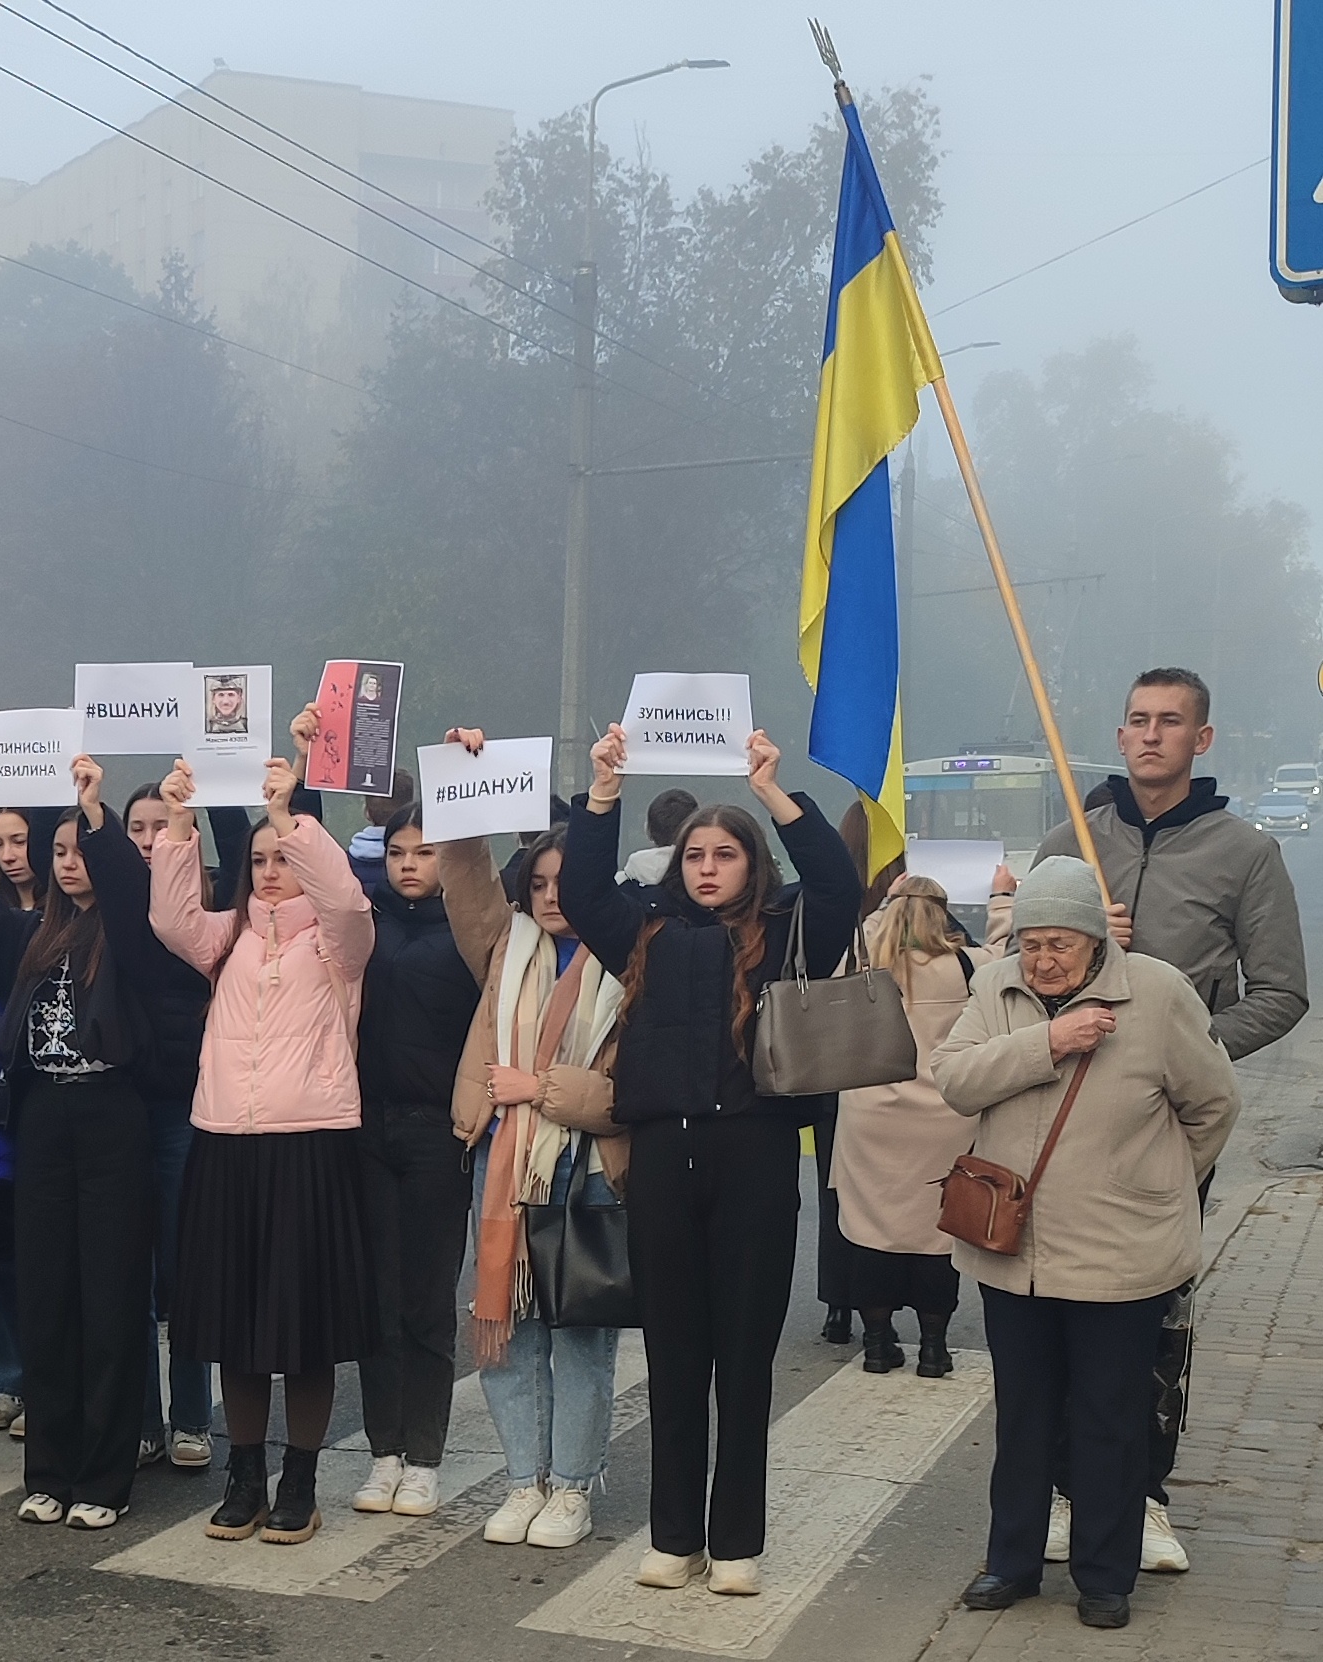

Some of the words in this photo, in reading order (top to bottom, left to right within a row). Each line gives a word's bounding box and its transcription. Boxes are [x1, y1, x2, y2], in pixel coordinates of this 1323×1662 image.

[86, 697, 179, 719] #ВШАНУЙ
[637, 707, 731, 722] ЗУПИНИСЬ!!!
[644, 731, 651, 743] 1
[655, 731, 727, 745] ХВИЛИНА
[436, 771, 534, 804] #ВШАНУЙ
